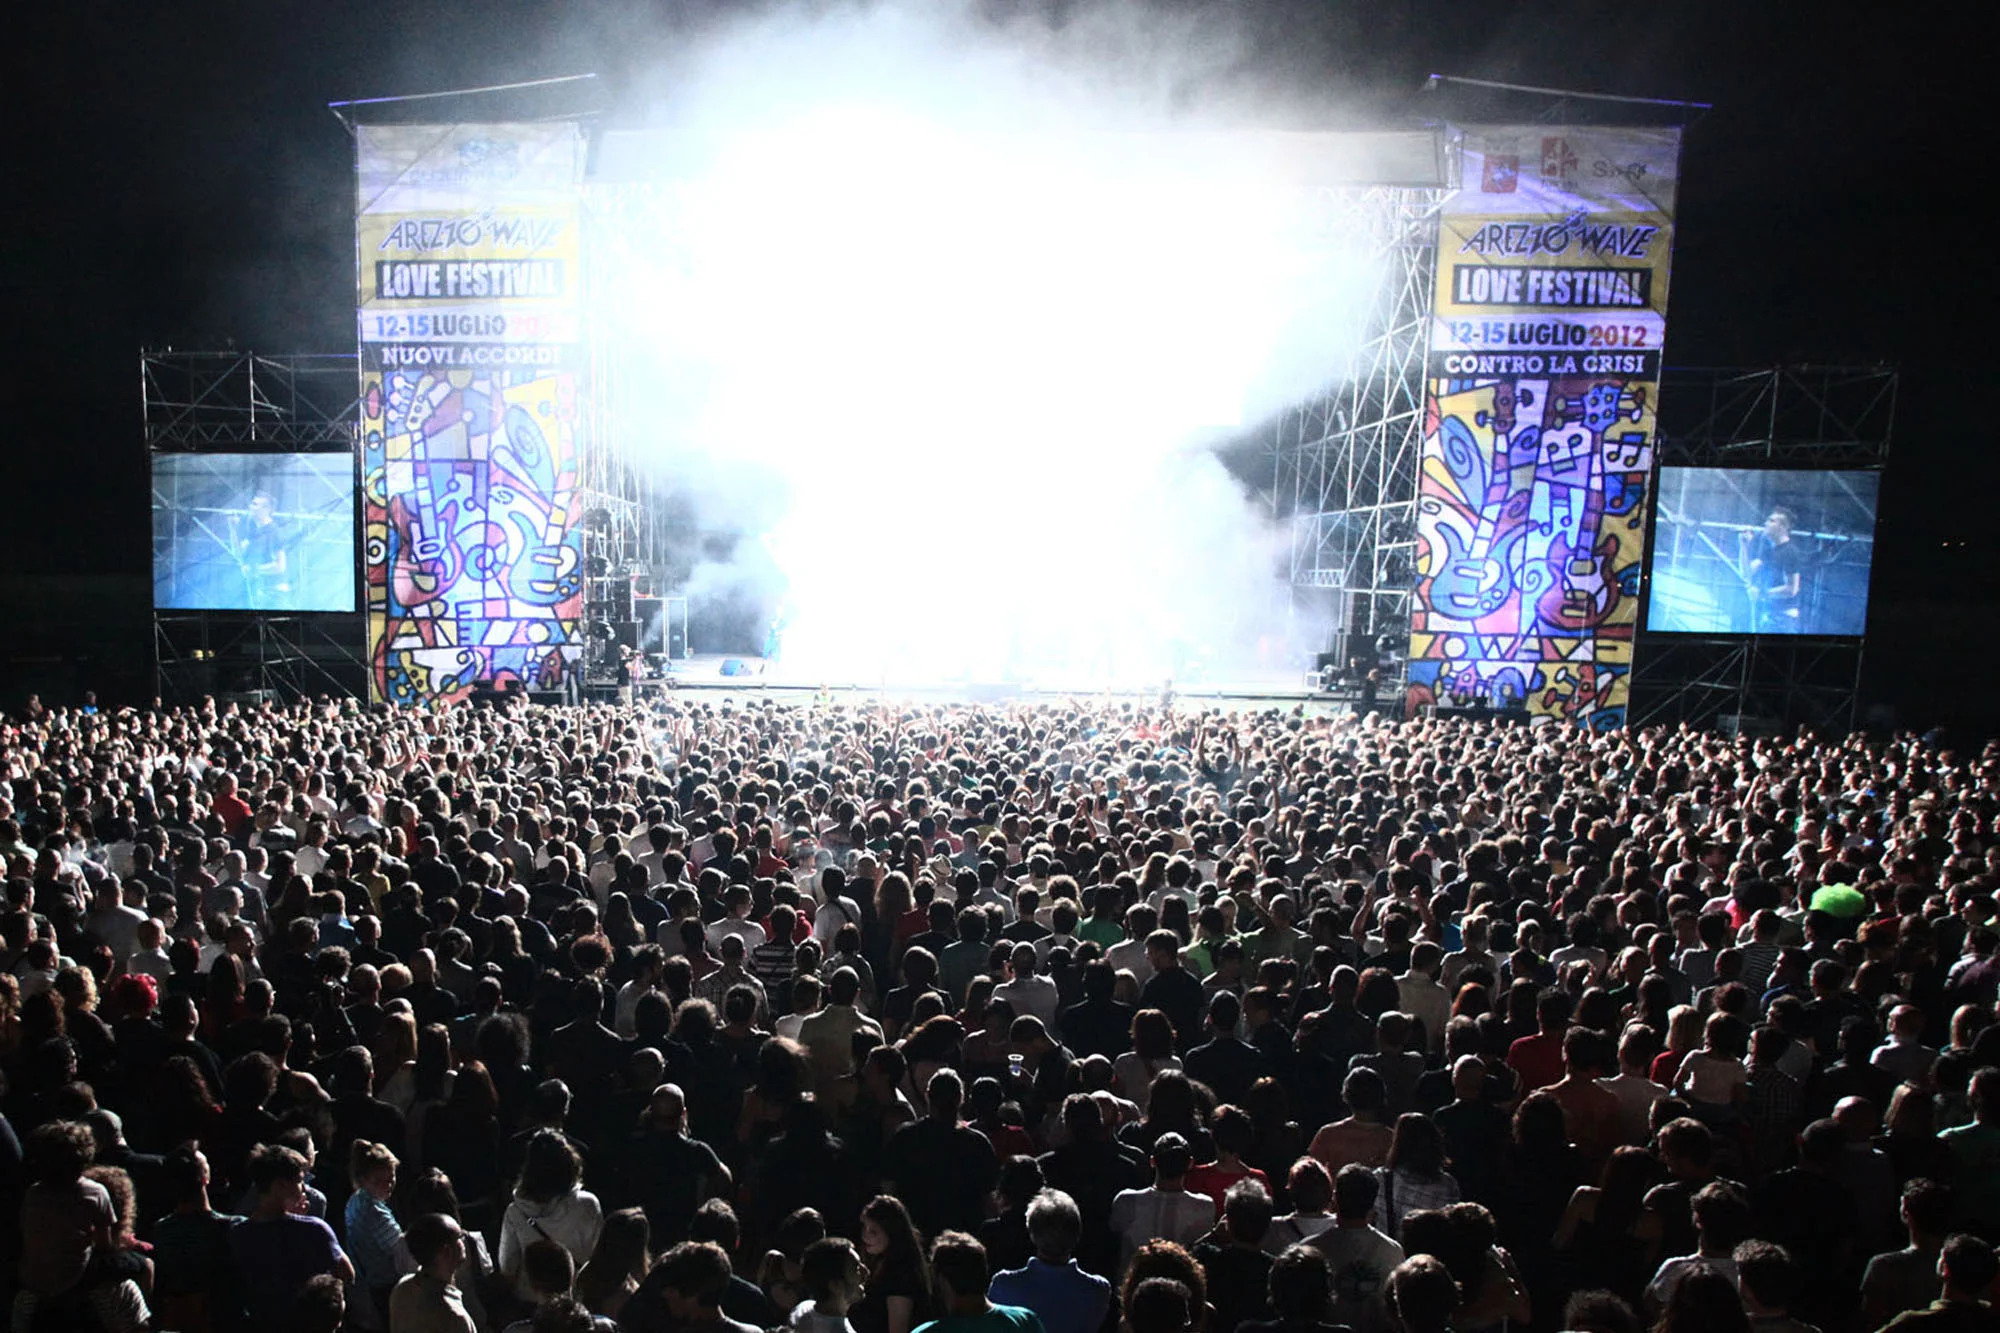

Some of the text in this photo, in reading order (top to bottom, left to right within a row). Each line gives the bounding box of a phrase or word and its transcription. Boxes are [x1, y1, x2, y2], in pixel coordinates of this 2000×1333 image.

[380, 216, 565, 252] AREZZO WAVE
[1460, 221, 1659, 258] AREZZO WAVE
[382, 262, 558, 297] LOVE FESTIVAL
[1458, 267, 1644, 306] LOVE FESTIVAL
[375, 315, 430, 337] 12-15
[1449, 321, 1648, 347] 12-15 LUGLIO 2012
[381, 345, 560, 366] NUOVI ACCORDI
[1444, 354, 1645, 374] CONTRO LA CRISI
